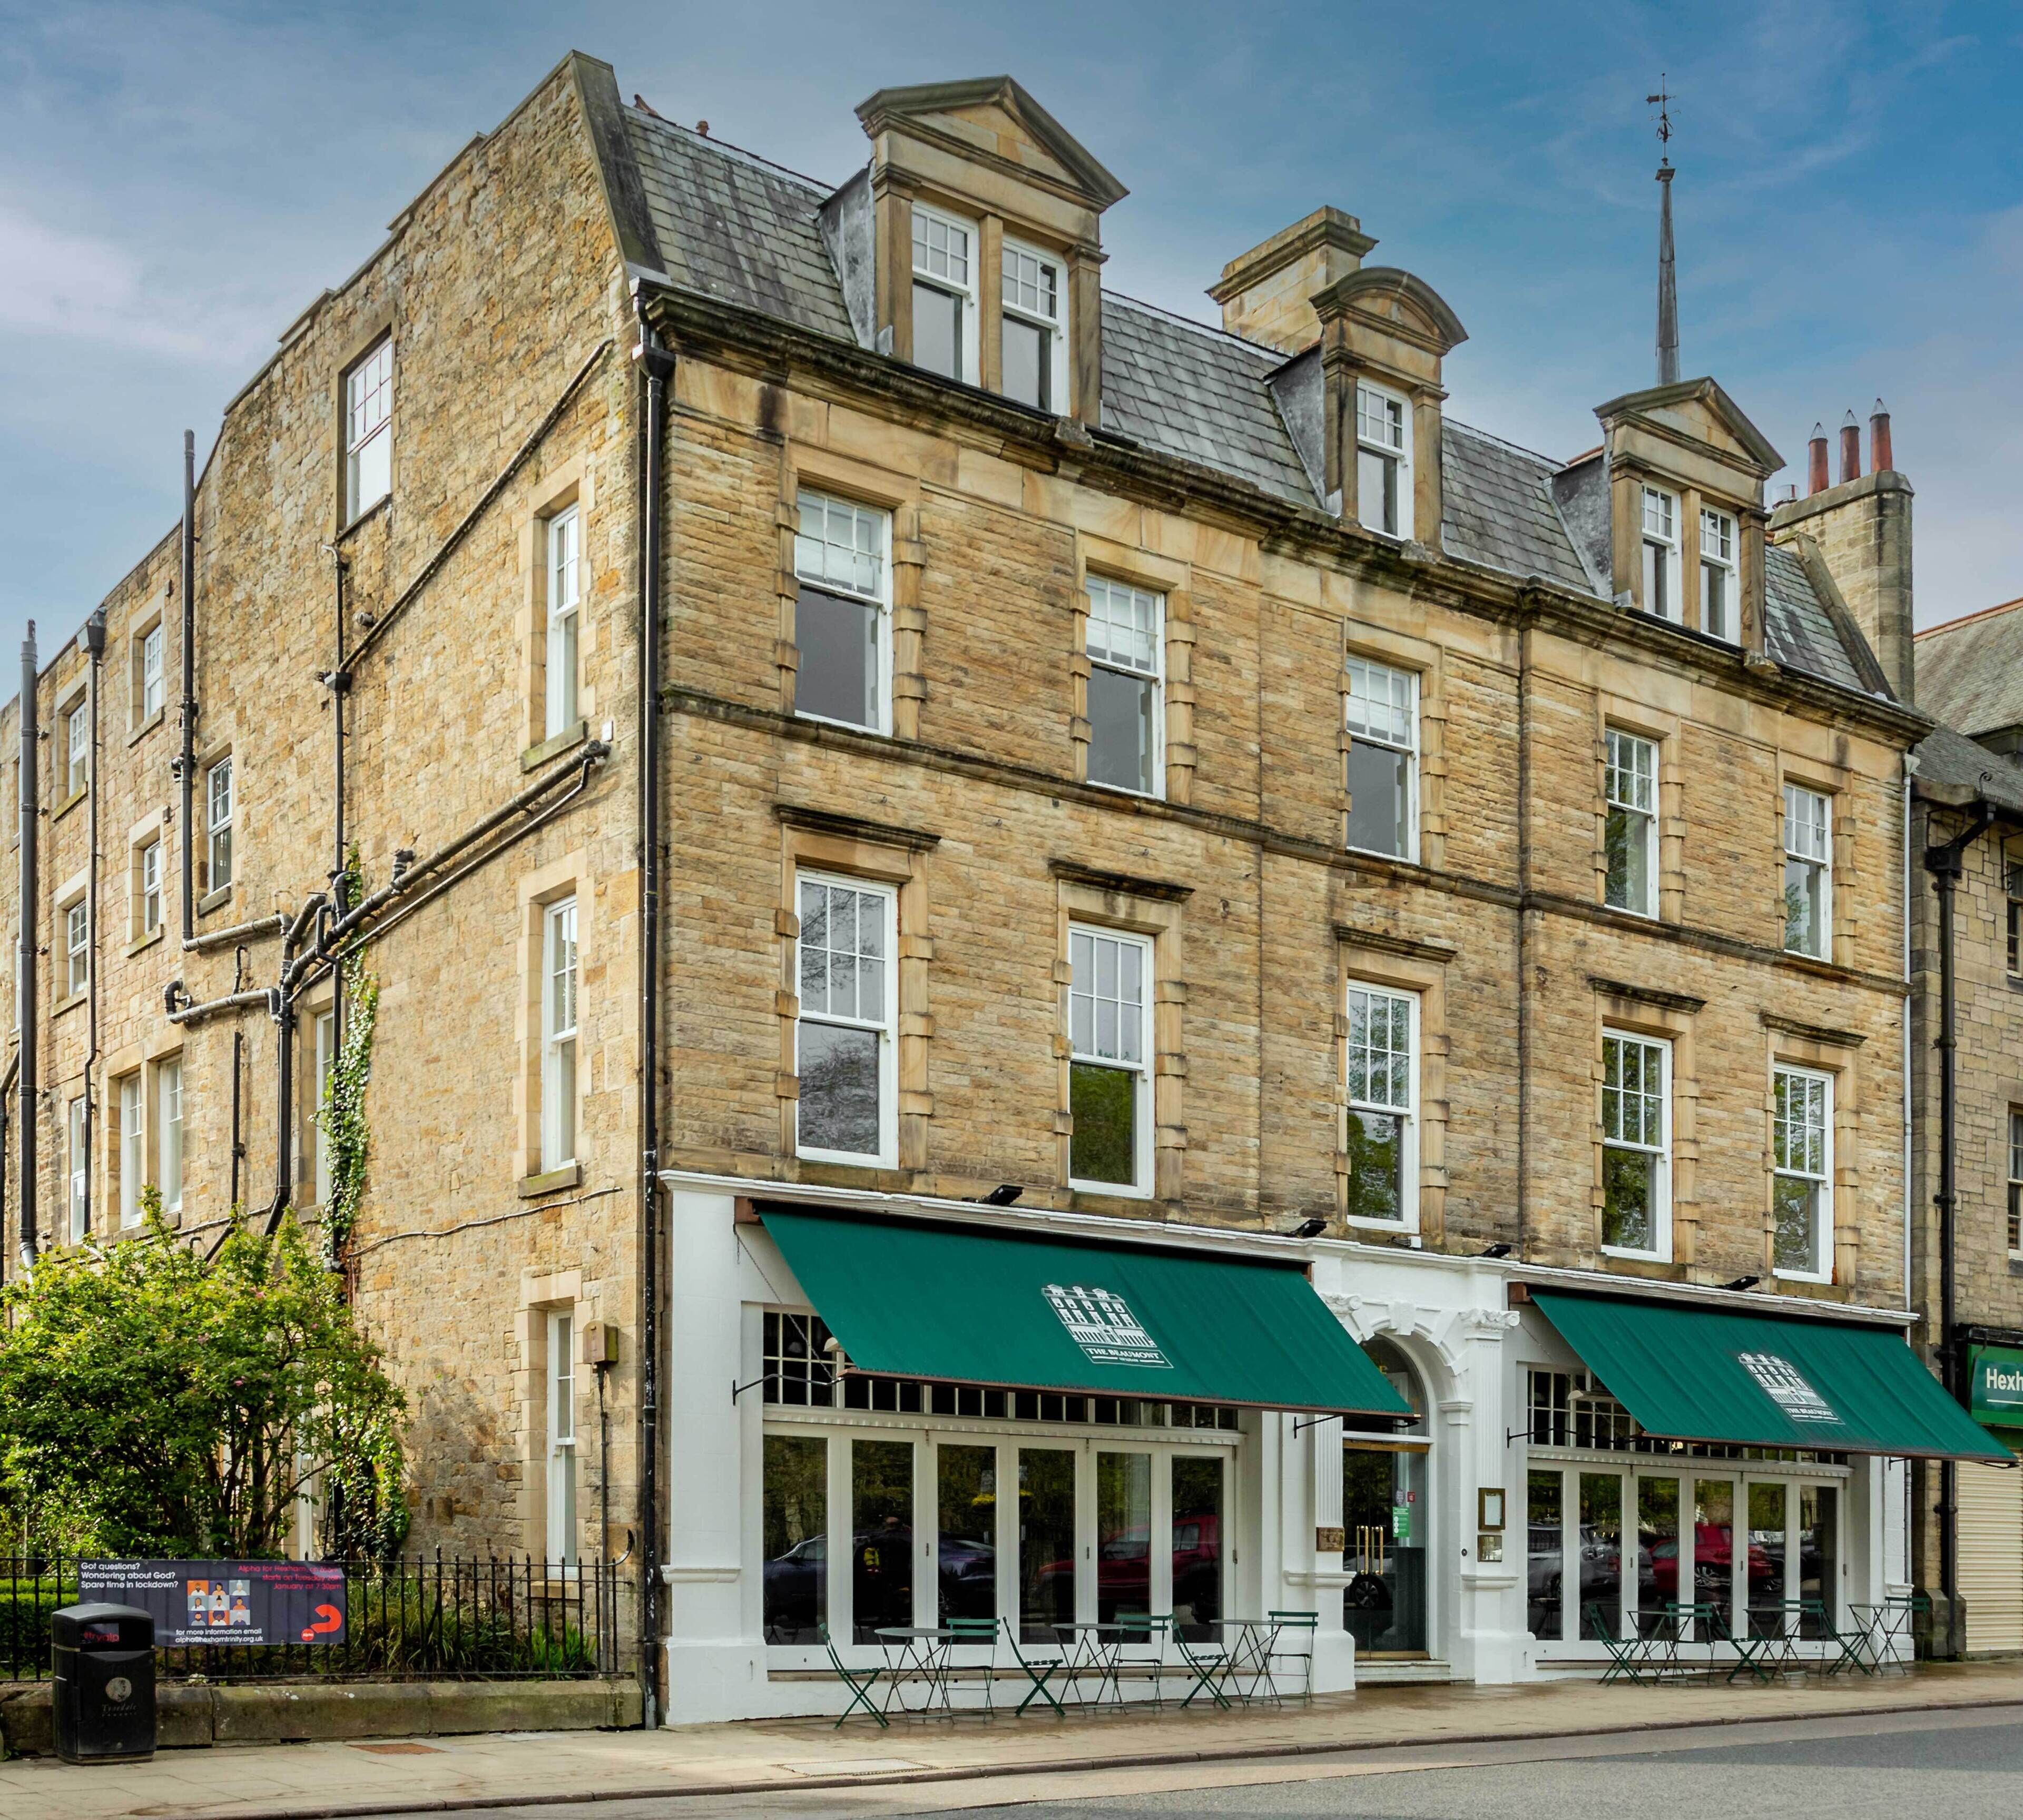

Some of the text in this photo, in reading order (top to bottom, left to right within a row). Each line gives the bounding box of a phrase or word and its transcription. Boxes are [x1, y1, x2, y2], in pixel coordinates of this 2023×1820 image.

[1108, 1350, 1159, 1359] BEAUMONT
[99, 1562, 140, 1571] questions?
[81, 1572, 125, 1580] Wondering
